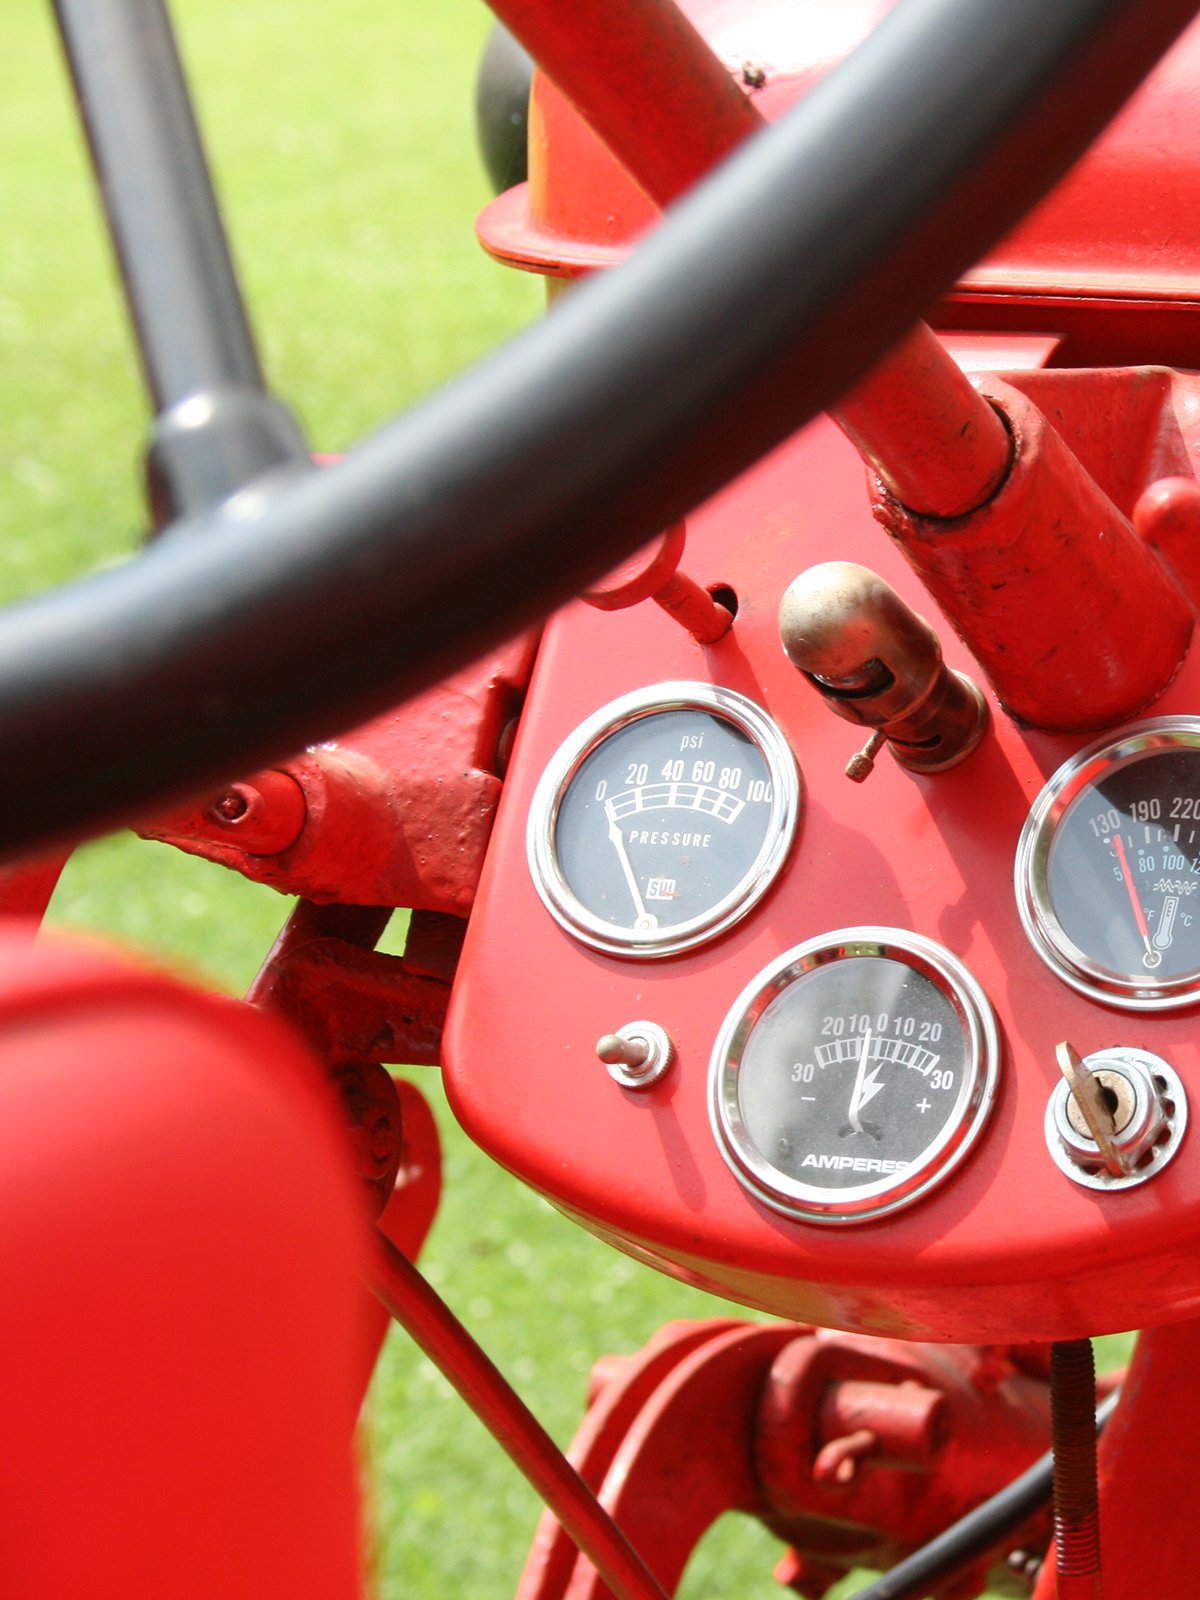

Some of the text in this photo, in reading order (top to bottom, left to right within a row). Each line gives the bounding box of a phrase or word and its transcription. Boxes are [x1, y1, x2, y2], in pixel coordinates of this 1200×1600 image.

[680, 732, 704, 751] psi
[595, 759, 772, 803] 0 20 40 60 80 100
[1089, 809, 1121, 837] 130
[1129, 798, 1161, 823] 190
[629, 830, 712, 848] PRESSURE
[1139, 856, 1155, 873] 80
[1162, 855, 1185, 871] 100
[791, 1013, 954, 1090] 30 20 10 0 10 20 30
